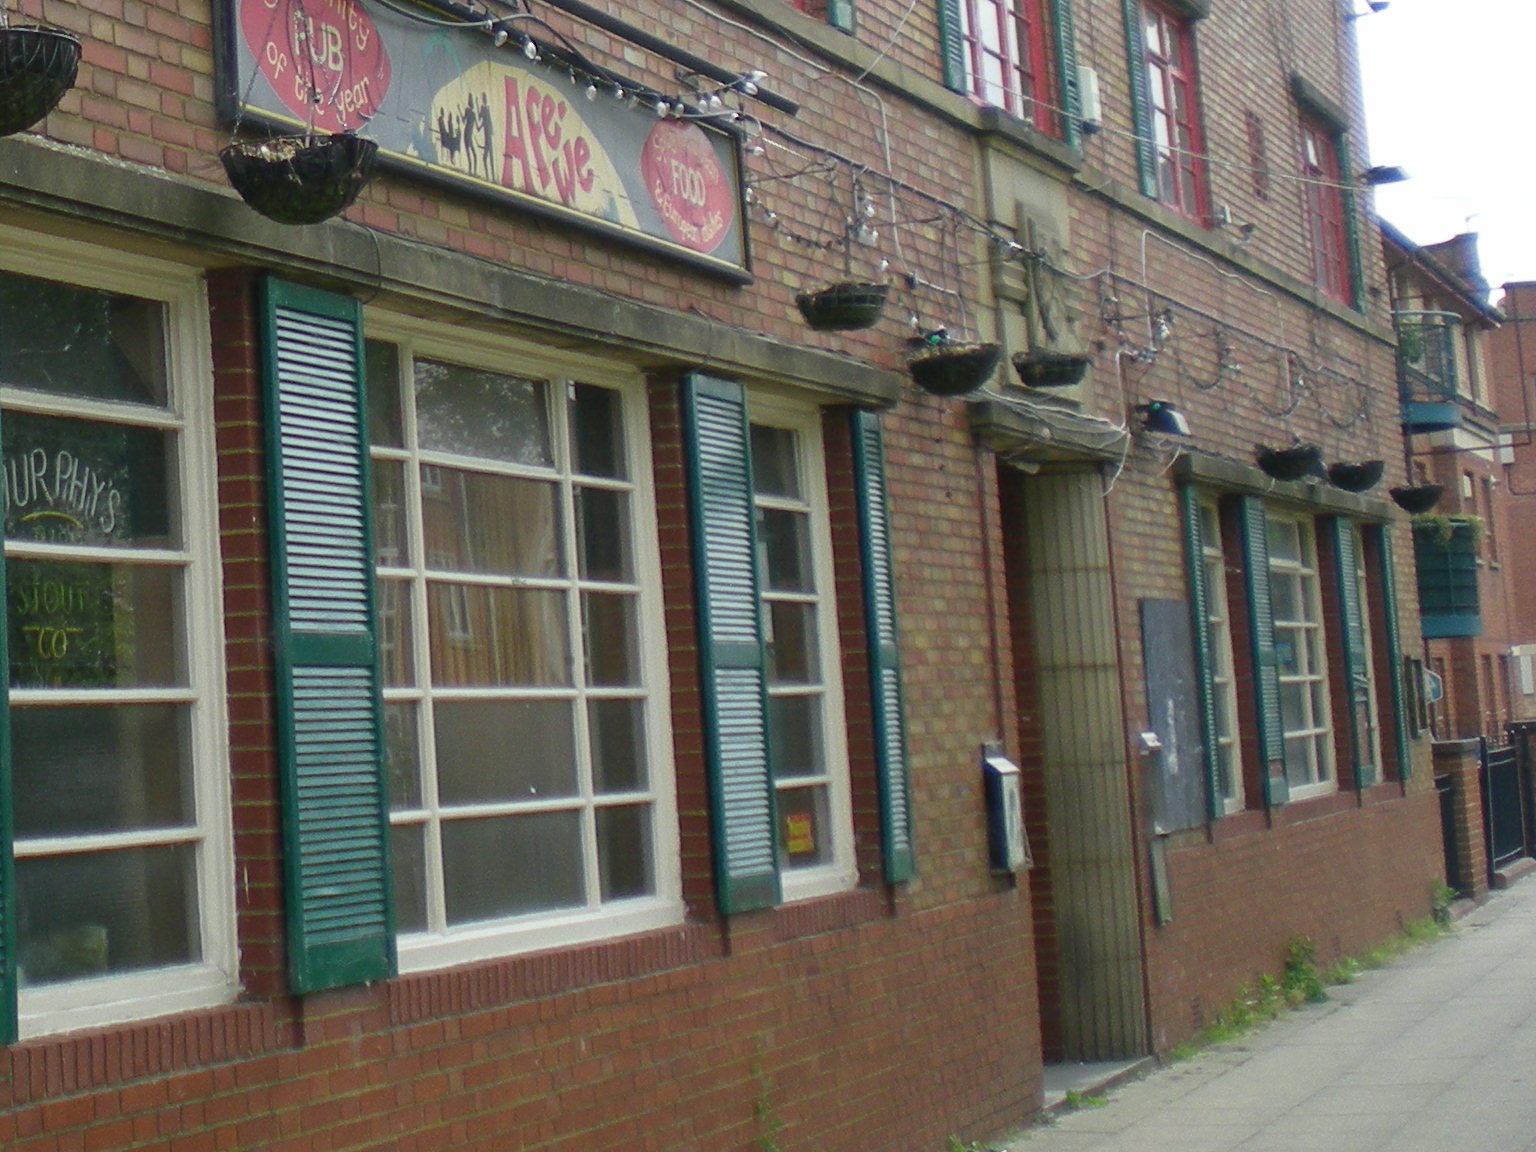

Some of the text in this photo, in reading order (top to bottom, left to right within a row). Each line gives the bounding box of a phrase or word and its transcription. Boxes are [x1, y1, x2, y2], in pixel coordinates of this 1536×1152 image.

[293, 10, 344, 72] PUB
[335, 76, 369, 126] year
[670, 158, 706, 207] FOOD
